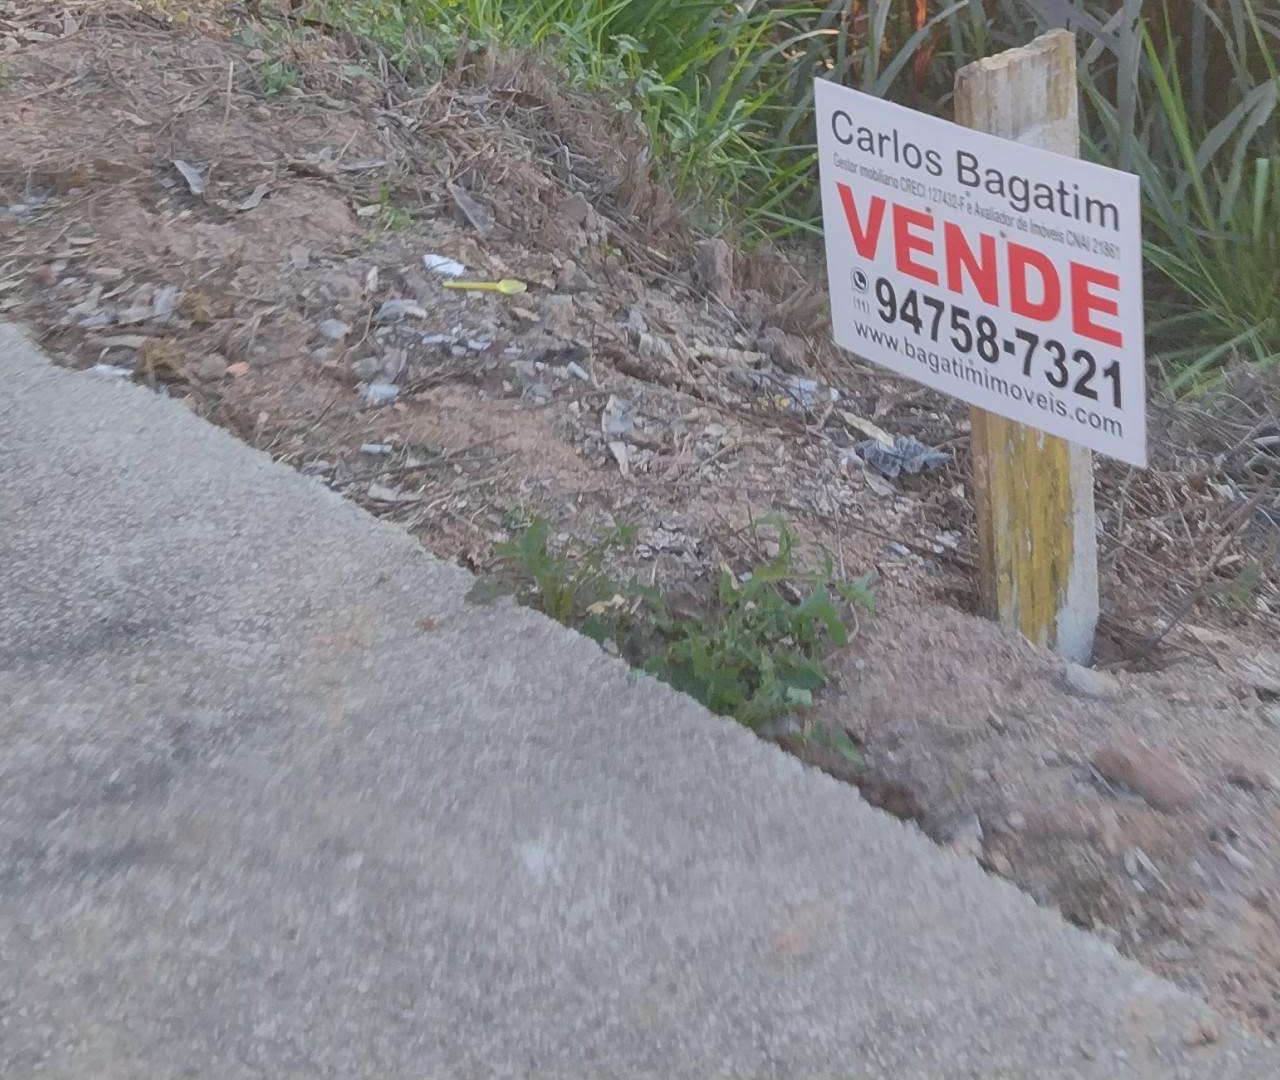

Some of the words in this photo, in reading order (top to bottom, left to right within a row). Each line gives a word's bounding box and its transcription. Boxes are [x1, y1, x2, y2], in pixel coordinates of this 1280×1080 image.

[831, 110, 943, 177] Carlos
[956, 150, 1120, 232] Bagatim
[836, 182, 1123, 348] VENDE
[855, 320, 1123, 438] www.bagatimimoveis.com
[875, 277, 1122, 410] 94758-7321
